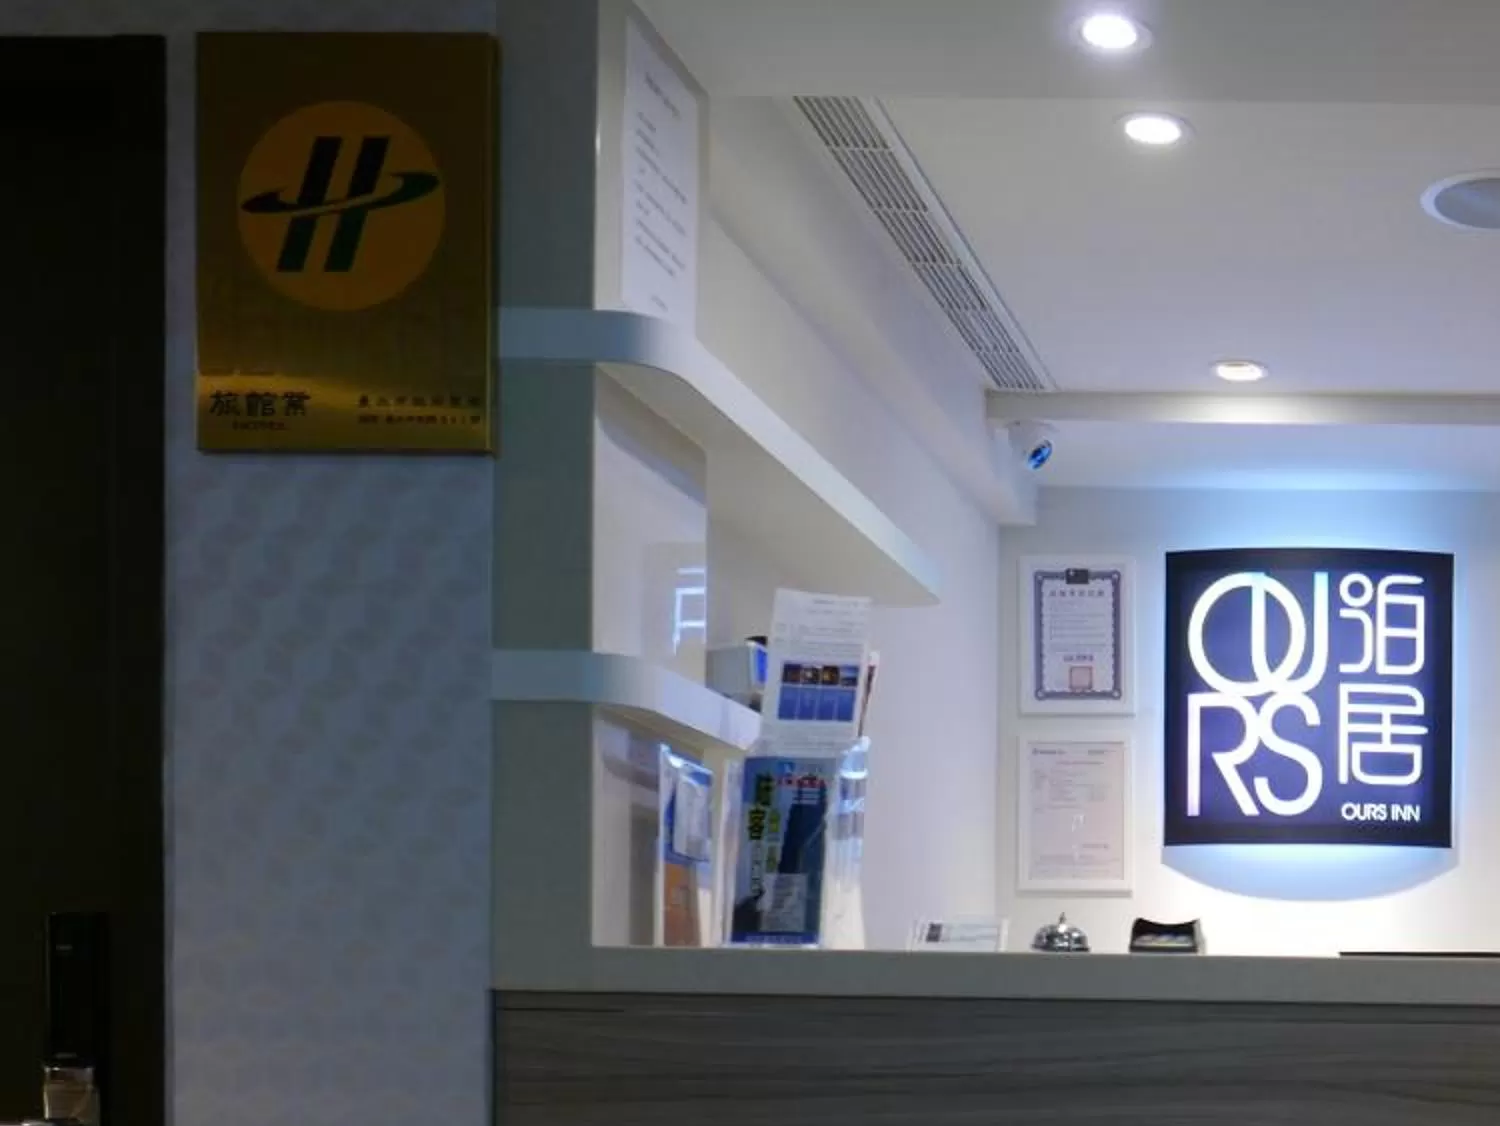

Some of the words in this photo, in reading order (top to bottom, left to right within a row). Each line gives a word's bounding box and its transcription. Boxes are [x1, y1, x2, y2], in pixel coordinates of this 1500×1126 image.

[208, 390, 312, 417] 旅館業
[1341, 803, 1387, 821] OURS
[1391, 804, 1420, 822] INN
